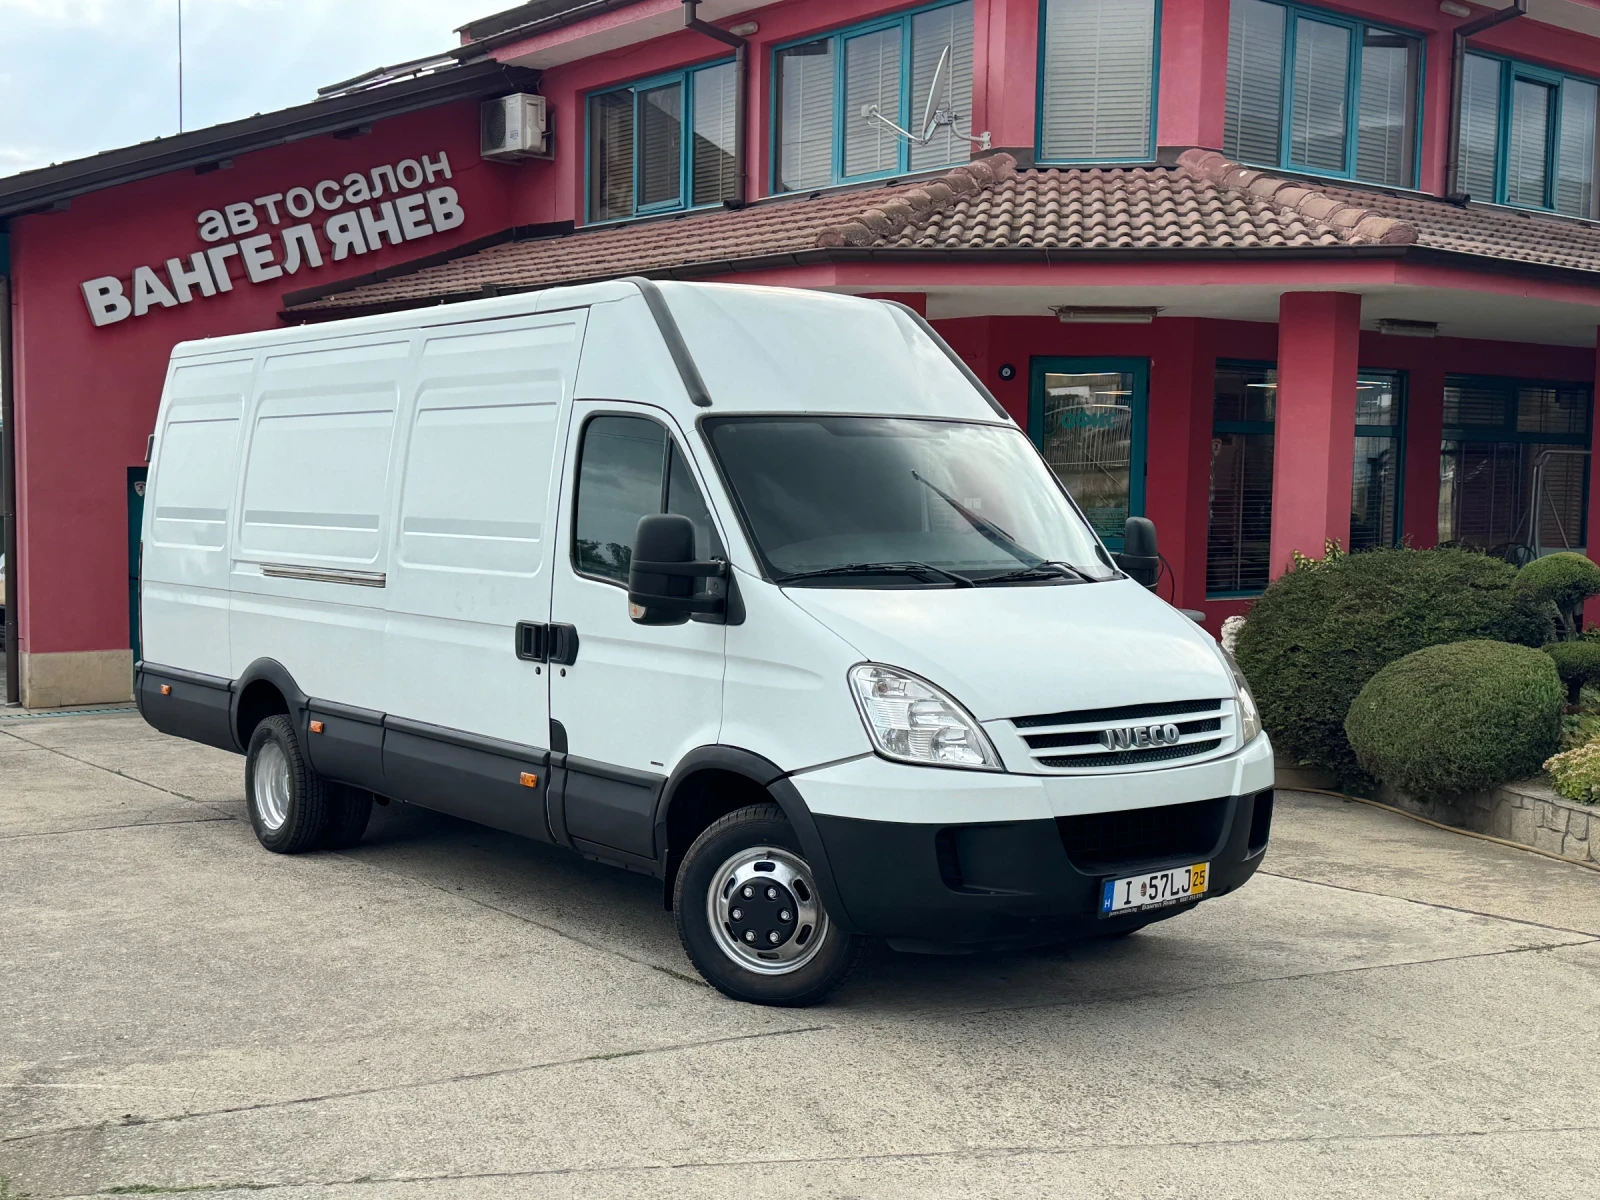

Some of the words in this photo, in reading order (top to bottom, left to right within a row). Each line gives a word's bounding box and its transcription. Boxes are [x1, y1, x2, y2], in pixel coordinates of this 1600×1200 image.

[197, 151, 452, 242] автосалон
[80, 223, 324, 327] ВАНГЕЛ
[323, 186, 465, 262] ЯНЕВ
[1103, 723, 1181, 751] IVECO
[1148, 868, 1192, 901] 57LJ
[1192, 870, 1206, 887] 25
[1103, 898, 1111, 909] H
